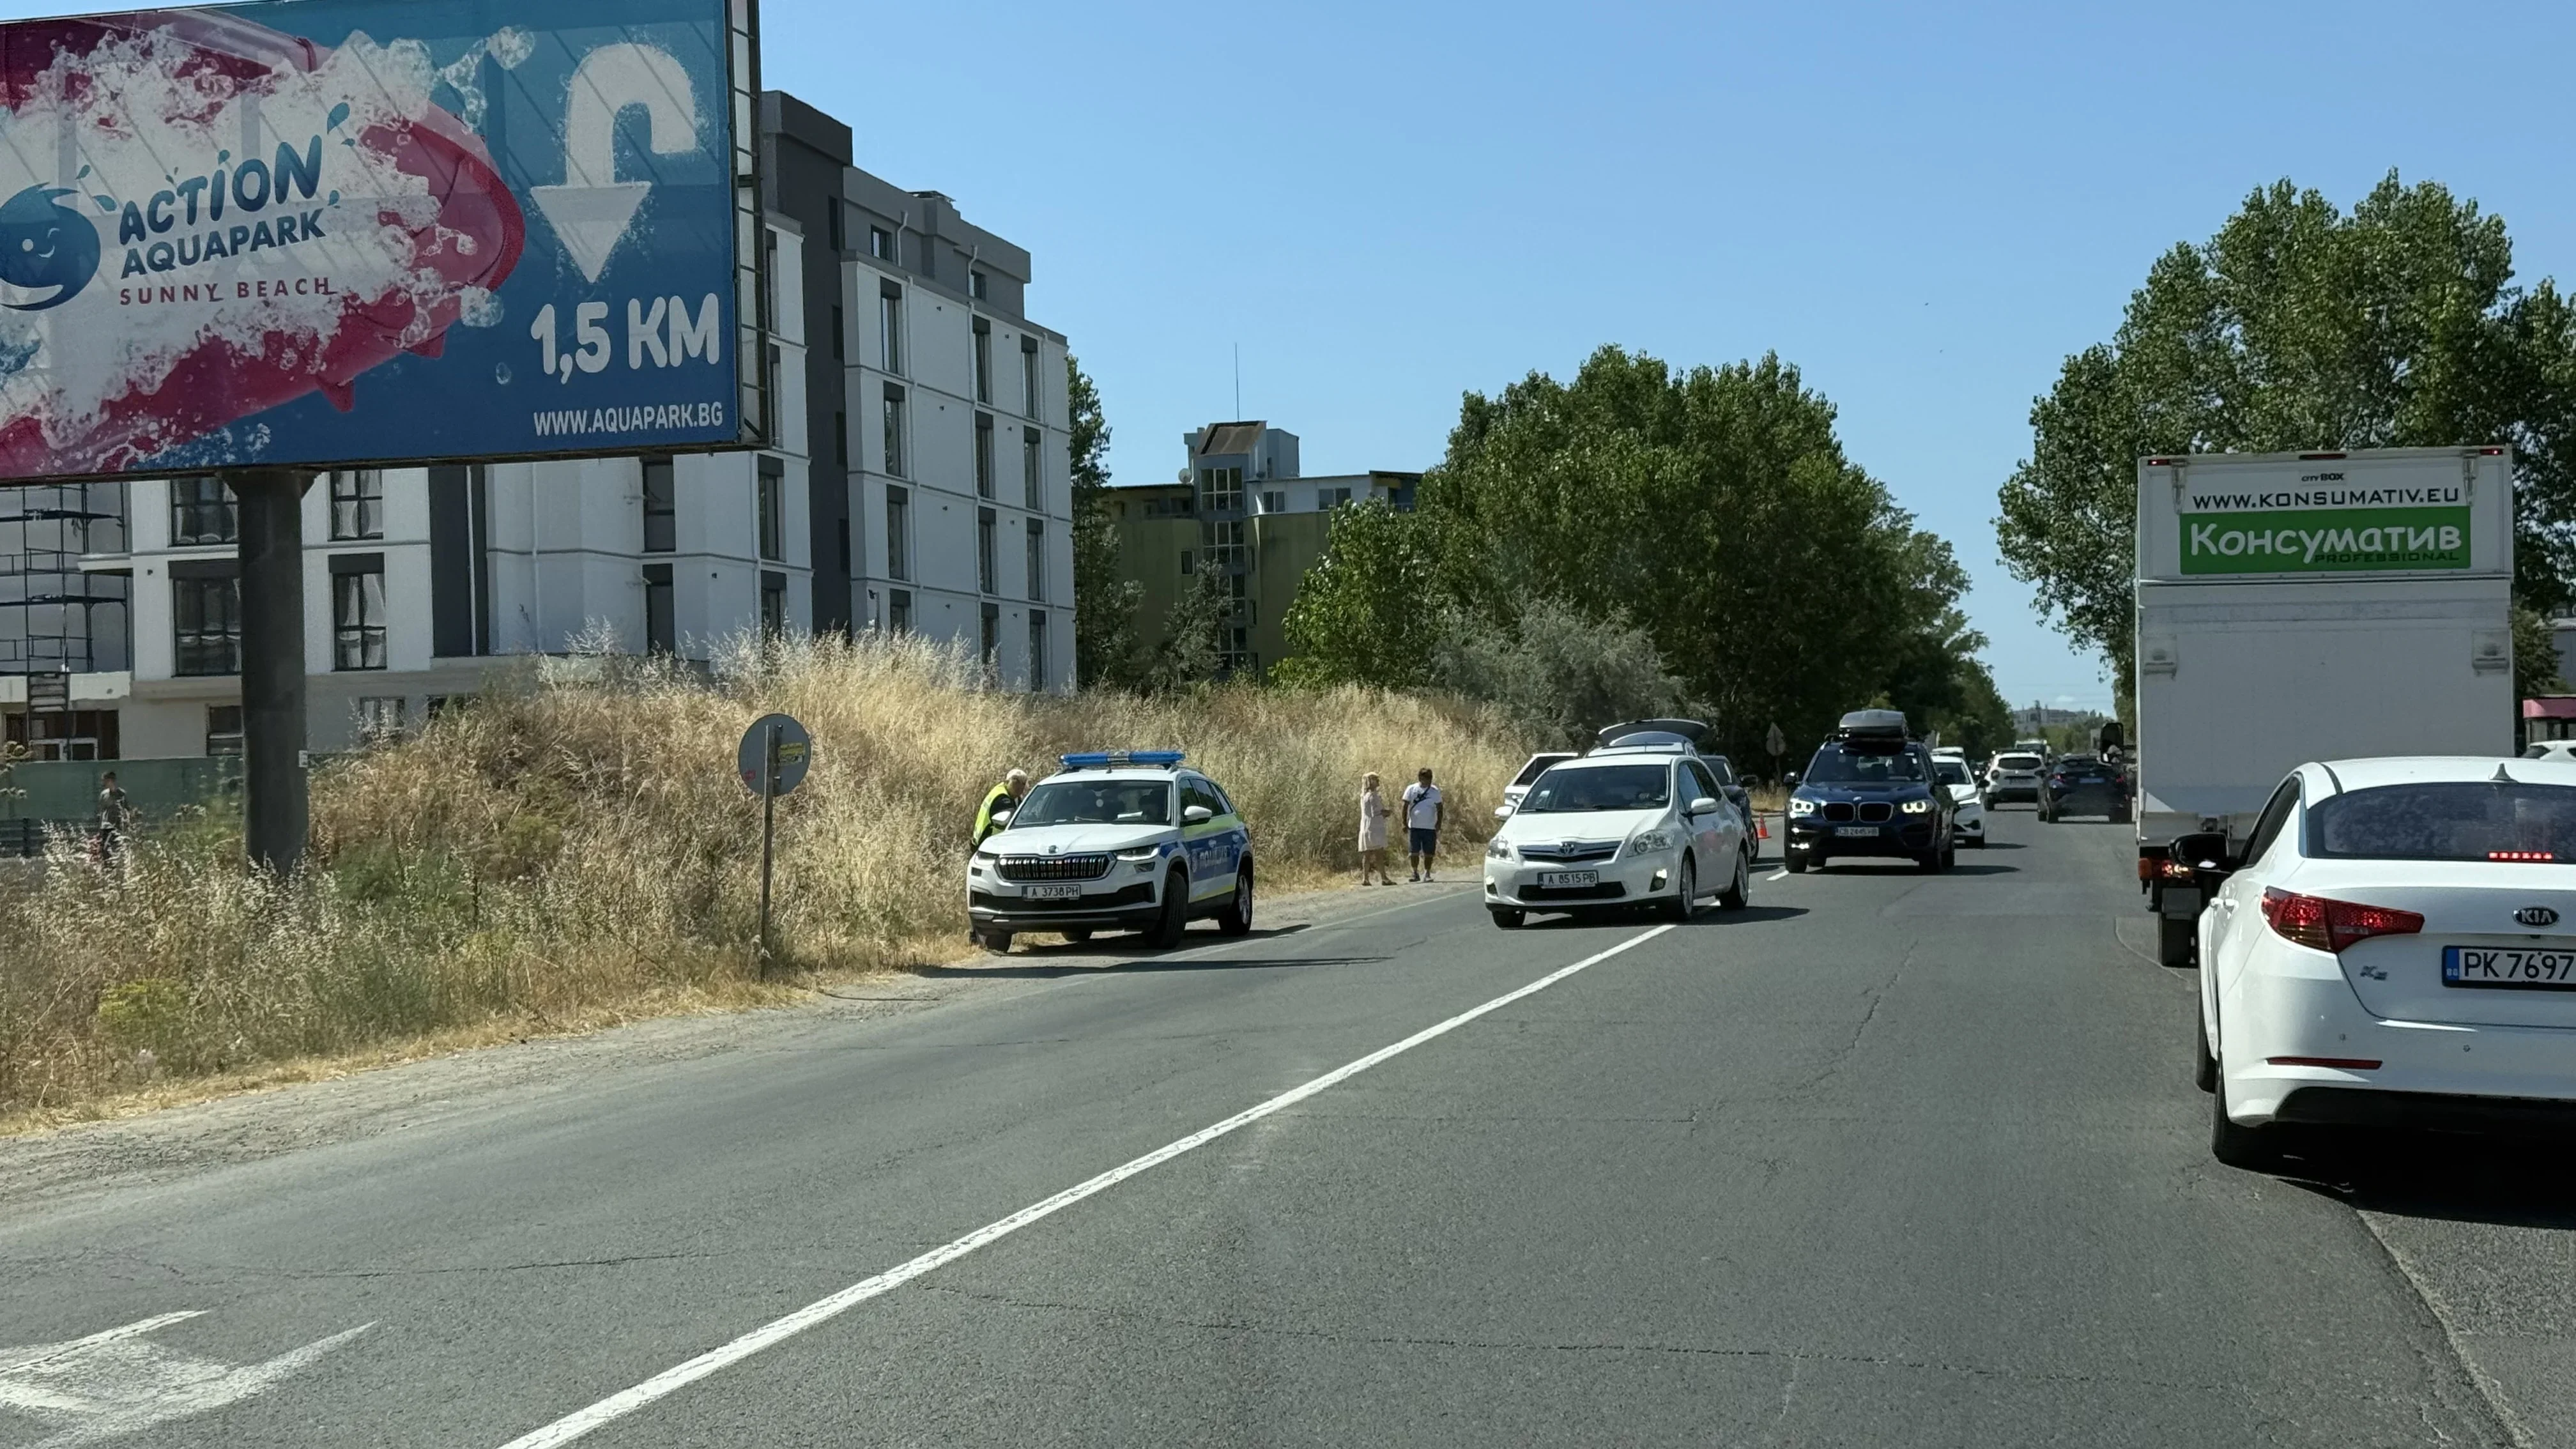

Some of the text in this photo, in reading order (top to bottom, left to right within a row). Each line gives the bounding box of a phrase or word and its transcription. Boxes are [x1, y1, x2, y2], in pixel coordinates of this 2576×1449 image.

[119, 134, 323, 245] ACTION
[120, 208, 326, 279] AQUAPARK
[120, 277, 331, 305] SUNNY BEACH
[530, 293, 720, 385] 1,5 KM
[533, 401, 723, 436] WWW.AQUAPARK.BG
[2320, 472, 2345, 482] BOX
[2193, 487, 2459, 509] WWW.KONSUMATIV.EU
[2190, 523, 2462, 564] Консуматив
[2314, 552, 2460, 564] PROFESSIONAL
[2520, 910, 2553, 923] KIA
[2464, 952, 2575, 980] PK 7697
